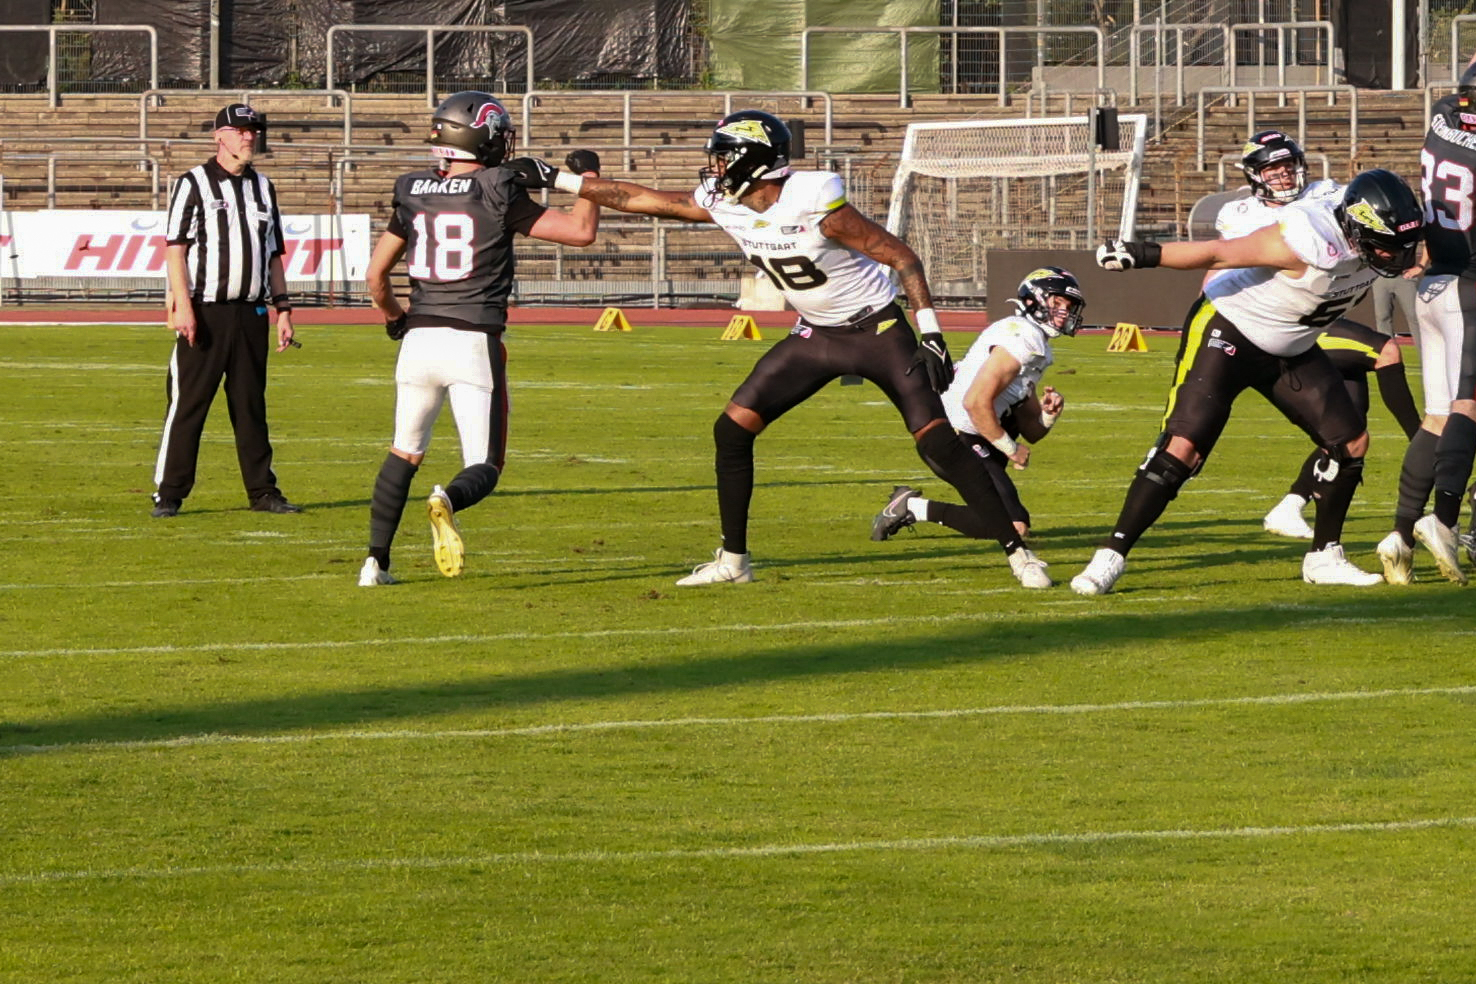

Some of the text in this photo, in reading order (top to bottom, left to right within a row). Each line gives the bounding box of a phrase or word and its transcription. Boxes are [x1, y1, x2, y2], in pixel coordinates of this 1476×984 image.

[408, 212, 475, 280] 18
[743, 239, 798, 251] STUTTGART
[750, 254, 828, 292] 18
